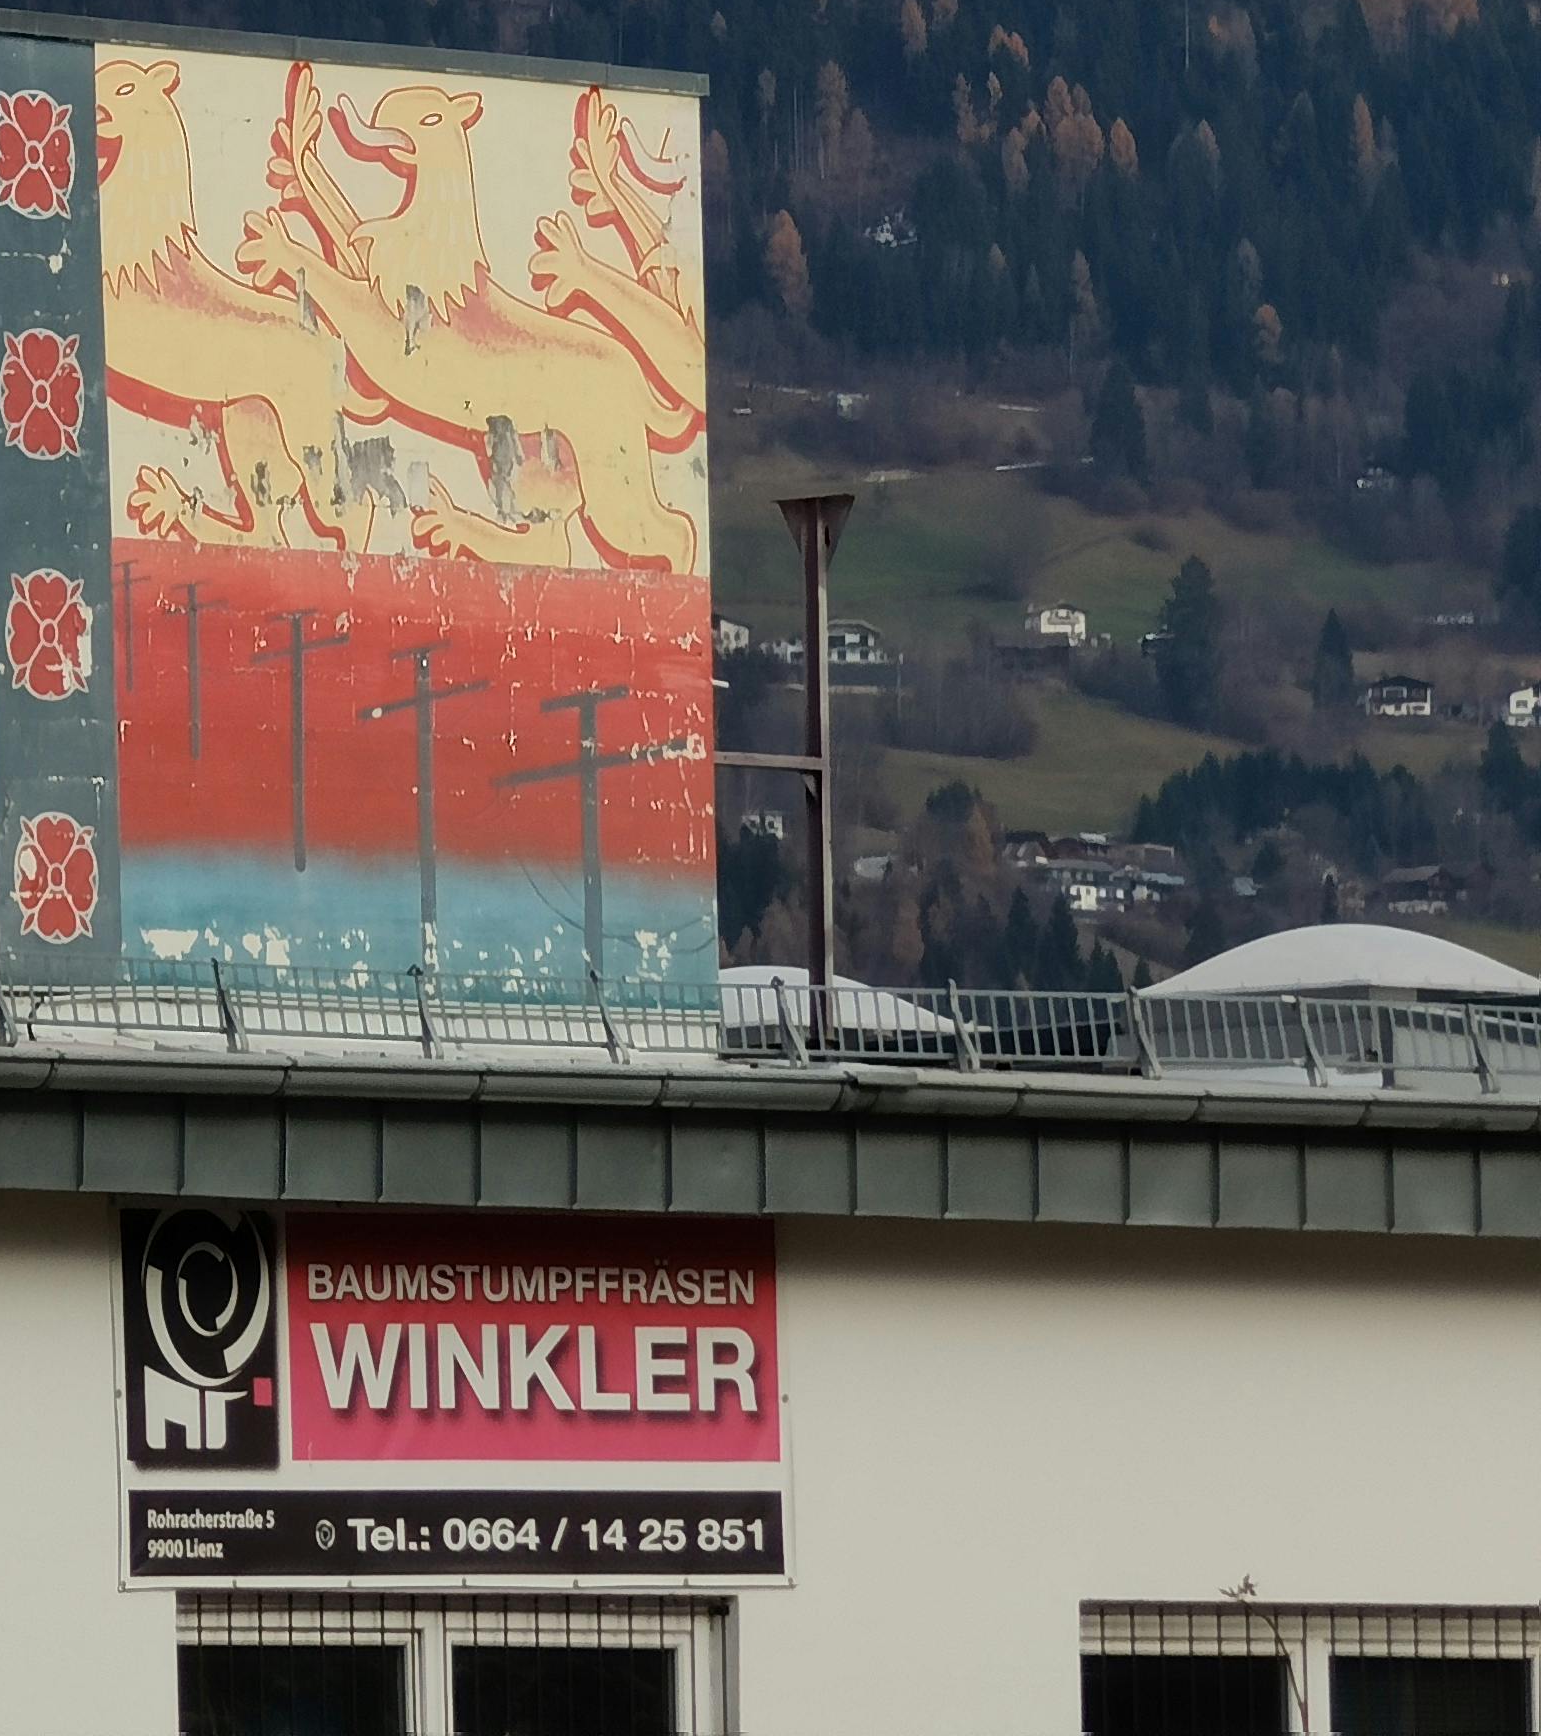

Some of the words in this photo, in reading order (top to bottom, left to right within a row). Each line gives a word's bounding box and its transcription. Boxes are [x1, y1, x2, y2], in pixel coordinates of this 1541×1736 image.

[307, 1258, 755, 1306] BAUMSTUMPFFRÄSEN
[308, 1321, 759, 1413] WINKLER
[146, 1508, 263, 1530] Rohracherstraße
[265, 1509, 276, 1530] 5
[347, 1517, 431, 1553] Tel.:
[442, 1517, 542, 1553] 0664
[581, 1517, 628, 1553] 14
[638, 1517, 687, 1553] 25
[696, 1517, 765, 1553] 851
[147, 1539, 184, 1559] 9900
[185, 1537, 225, 1559] Lienz
